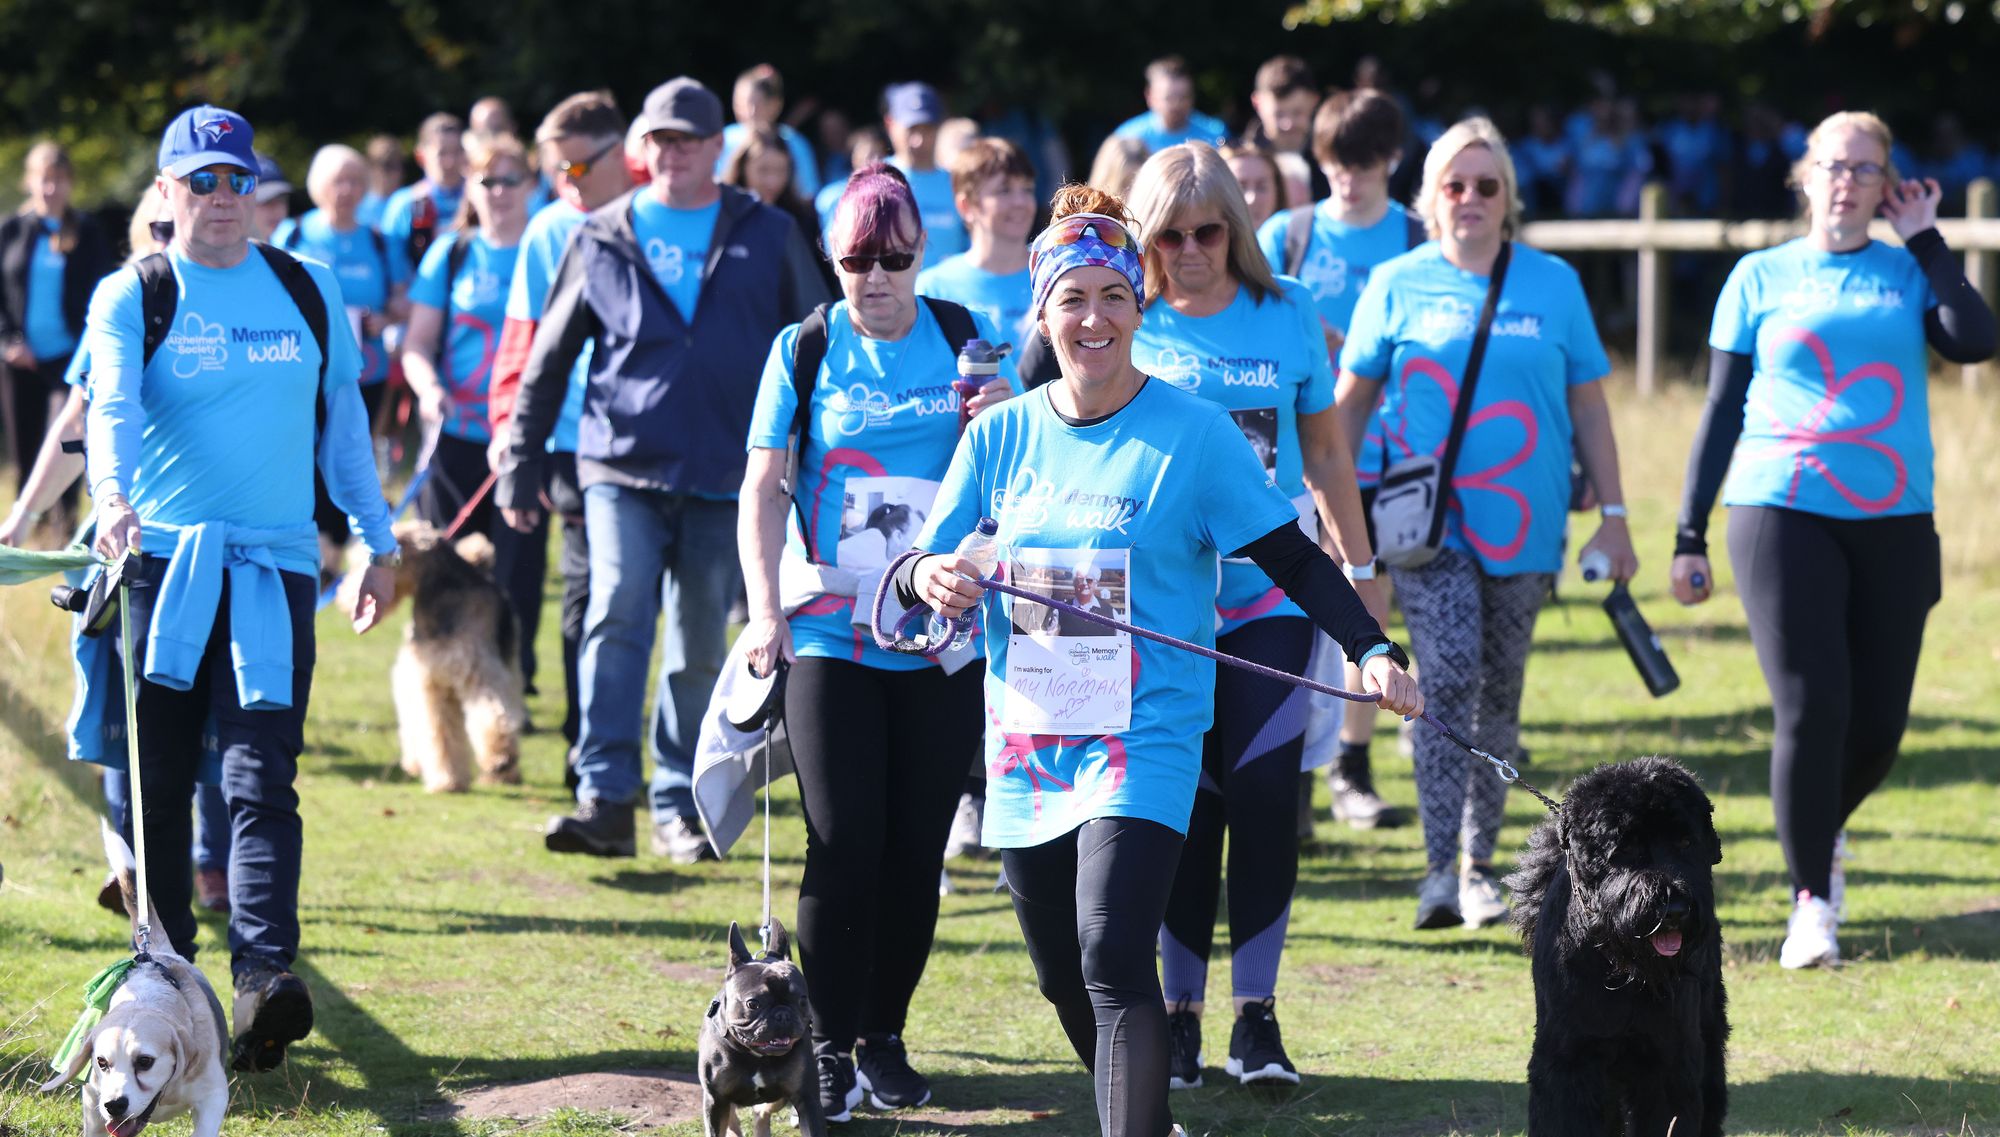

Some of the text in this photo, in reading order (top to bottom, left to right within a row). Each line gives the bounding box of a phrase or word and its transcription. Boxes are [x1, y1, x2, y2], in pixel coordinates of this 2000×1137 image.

[232, 327, 301, 344] Memory
[178, 345, 217, 356] Society
[247, 335, 302, 363] walk
[1207, 356, 1280, 374] Memory
[1223, 363, 1280, 390] walk
[896, 384, 956, 403] Memo
[1065, 489, 1145, 518] Memory
[1066, 505, 1132, 536] walk
[1091, 647, 1119, 656] Memory
[1096, 653, 1116, 661] walk
[1023, 666, 1043, 675] walking
[1014, 673, 1129, 702] MY NORMAN
